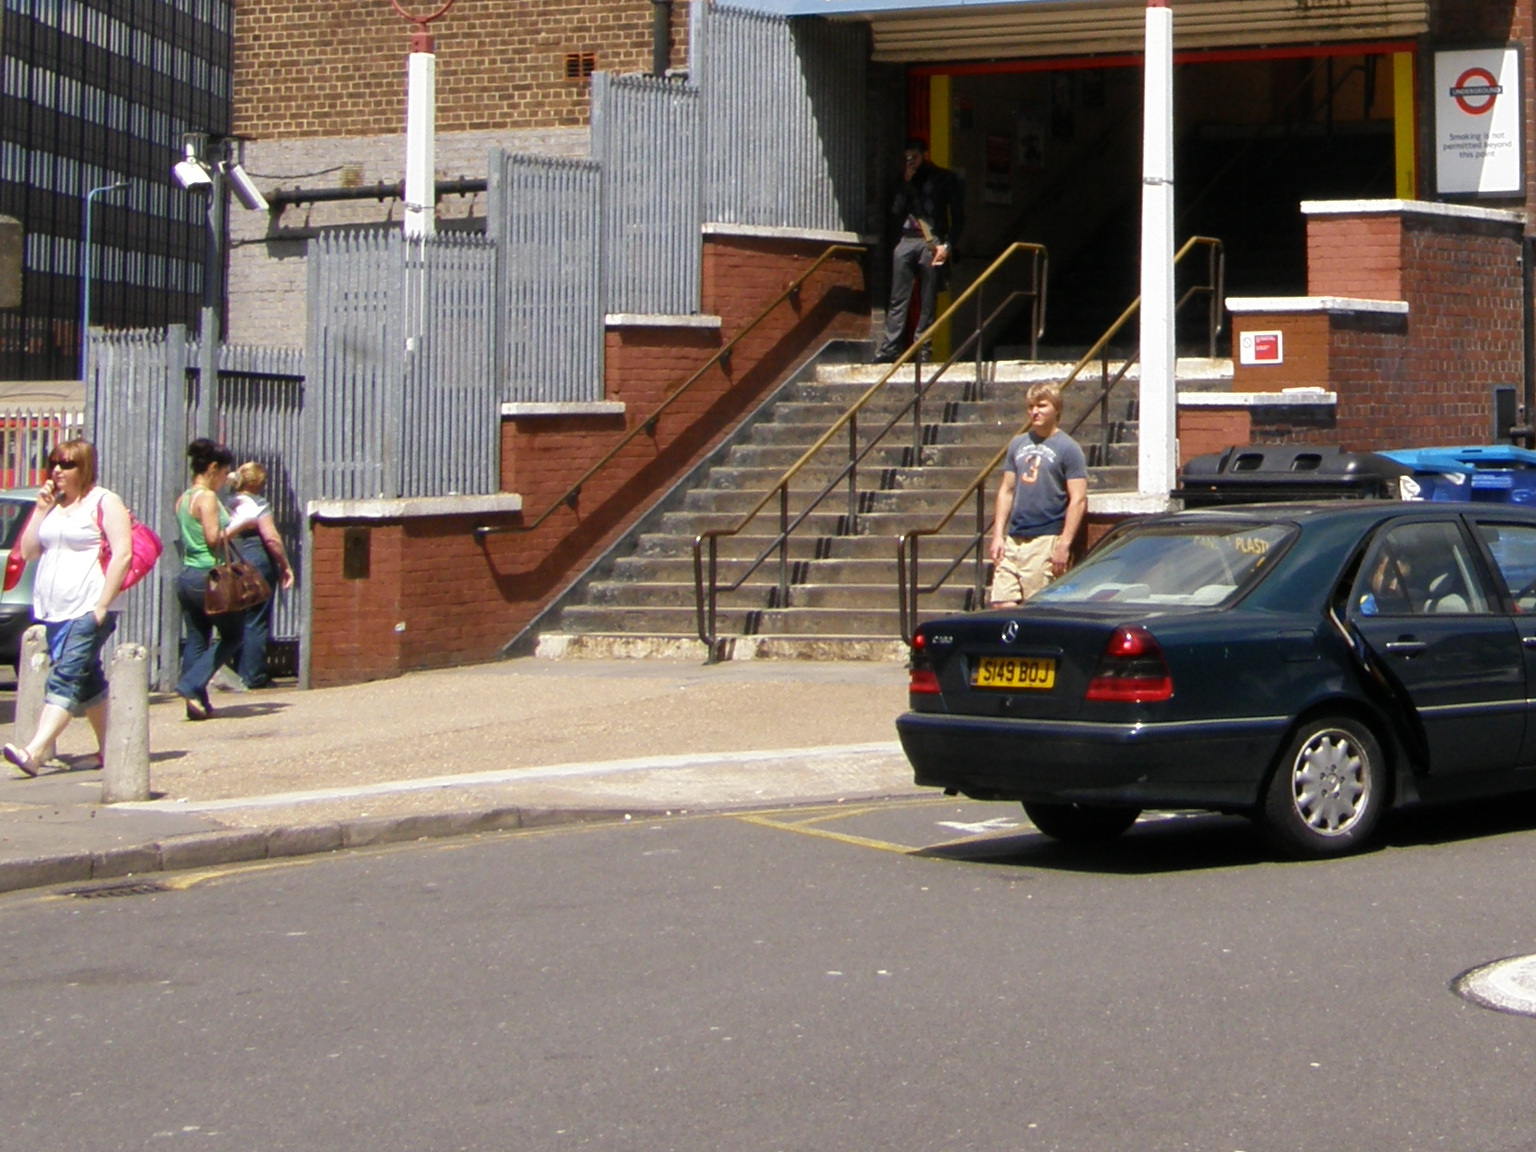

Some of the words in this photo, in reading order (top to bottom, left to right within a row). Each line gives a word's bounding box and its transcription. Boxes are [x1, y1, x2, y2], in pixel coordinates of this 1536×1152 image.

[1451, 87, 1501, 95] UNDERGROUND
[1449, 133, 1481, 141] Smoking
[1443, 141, 1482, 151] permitted
[1484, 141, 1512, 149] beyond
[1022, 455, 1042, 484] 3
[983, 660, 1015, 682] S149
[1018, 661, 1050, 684] BOJ
